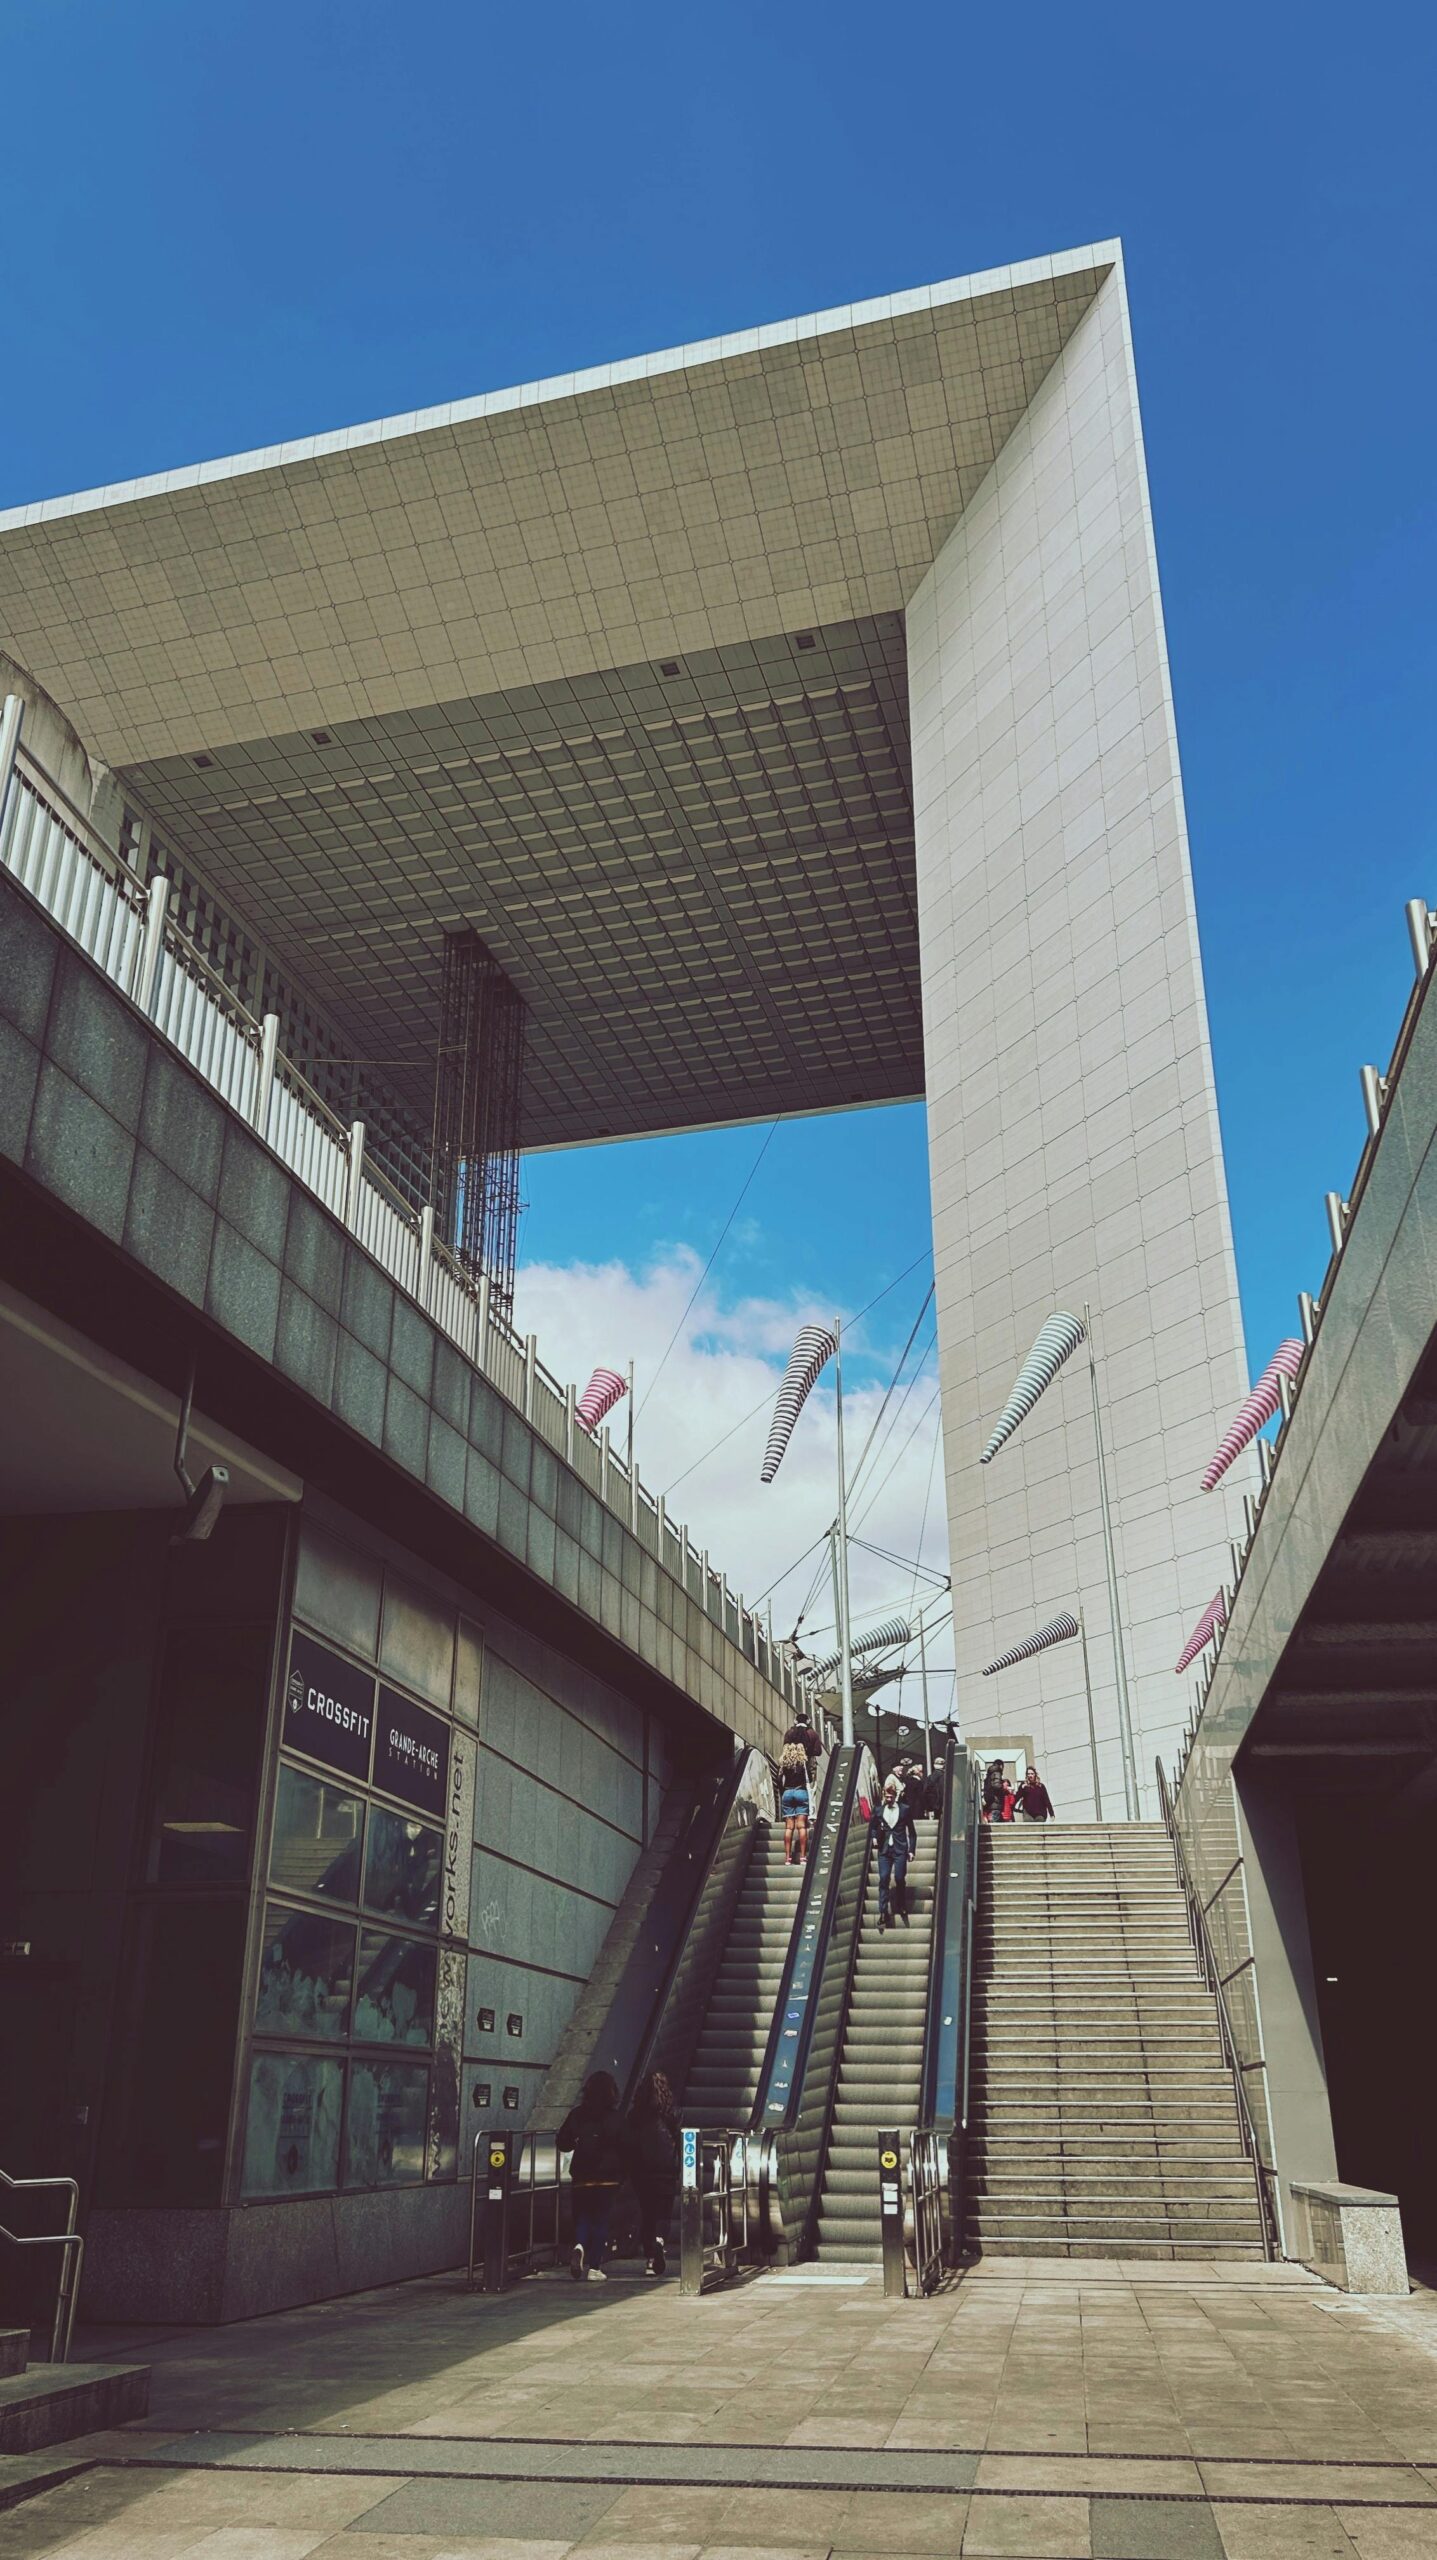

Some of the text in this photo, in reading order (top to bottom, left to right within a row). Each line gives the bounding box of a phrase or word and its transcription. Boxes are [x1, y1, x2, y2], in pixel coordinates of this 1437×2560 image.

[307, 1687, 370, 1739] CROSSFIT
[388, 1746, 438, 1781] STATION
[390, 1728, 439, 1769] GRANDE-ARCHE
